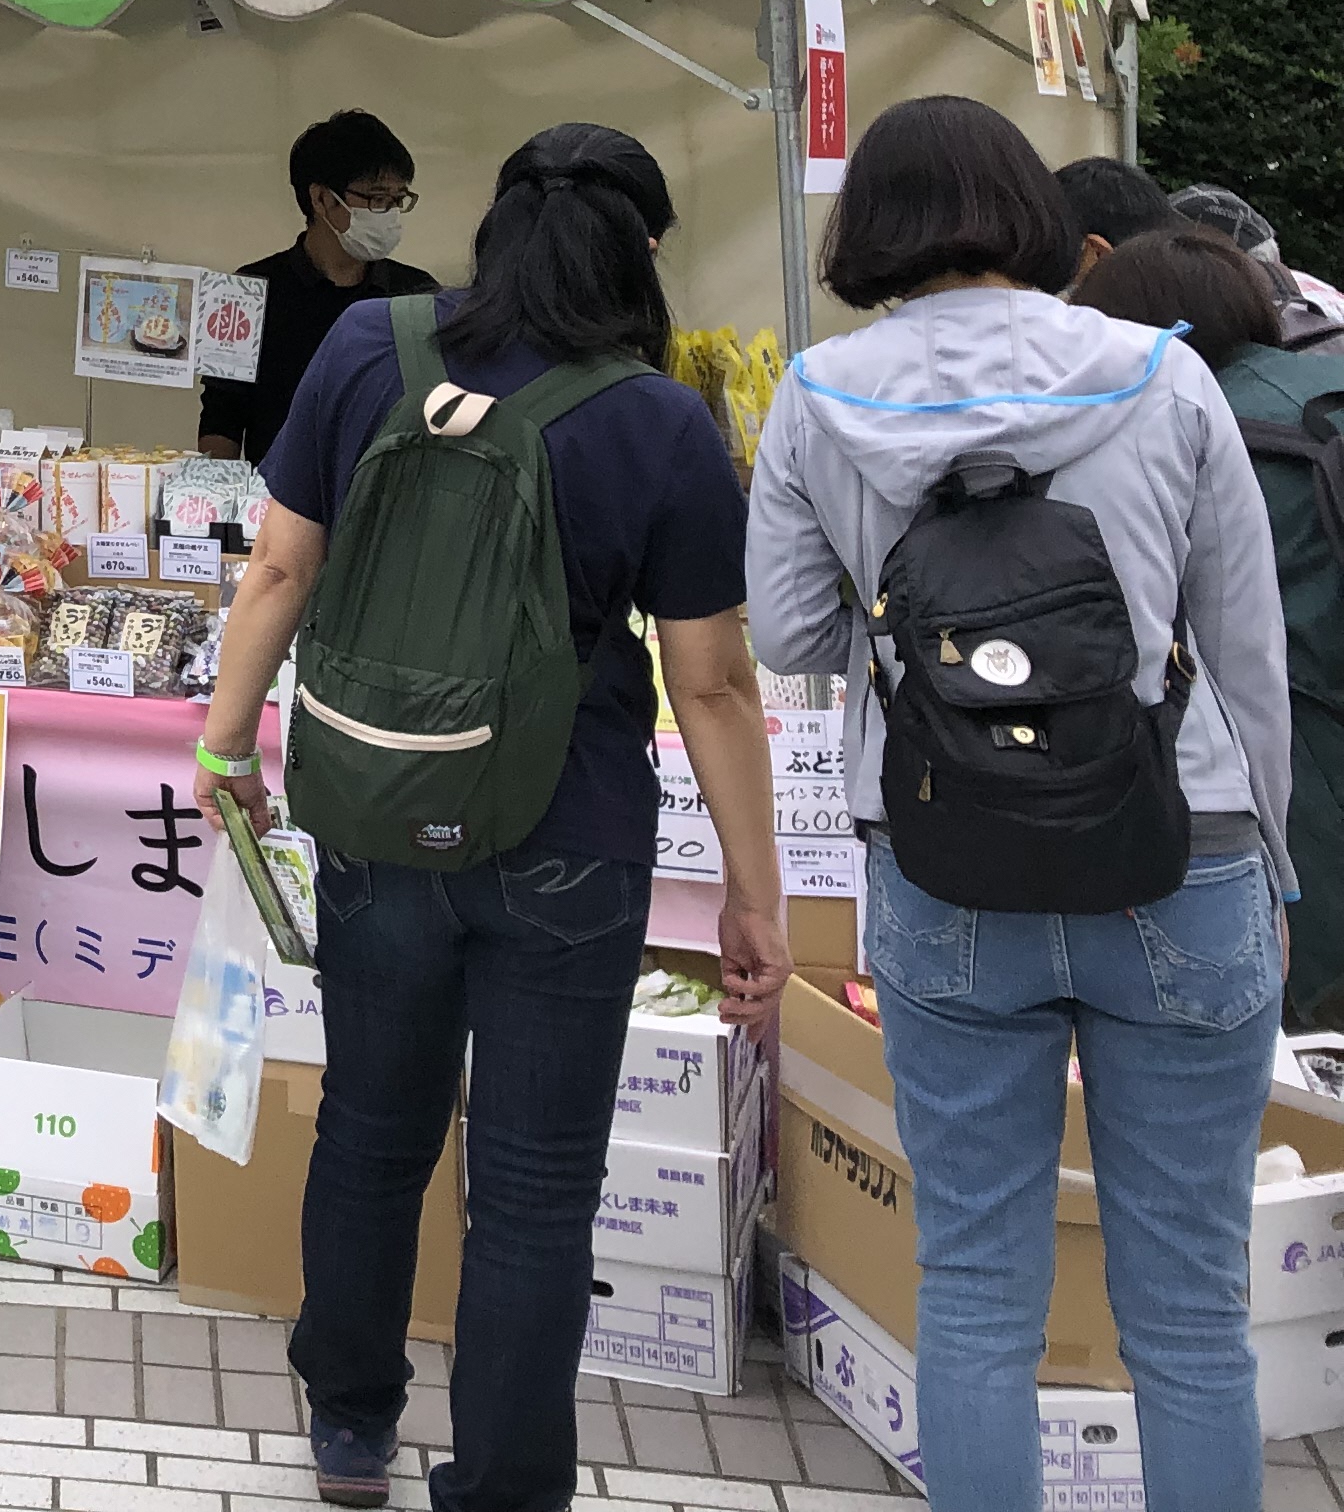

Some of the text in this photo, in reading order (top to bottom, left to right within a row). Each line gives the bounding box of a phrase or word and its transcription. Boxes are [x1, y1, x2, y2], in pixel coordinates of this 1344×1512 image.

[207, 300, 252, 343] 桃
[86, 676, 112, 688] ¥540
[776, 809, 853, 832] 1600
[801, 874, 834, 888] ¥470
[33, 1111, 77, 1139] 110
[593, 1339, 605, 1353] 11
[612, 1342, 624, 1356] 12
[629, 1345, 641, 1359] 13
[646, 1348, 659, 1362] 14
[1076, 1491, 1089, 1505] 10
[1094, 1491, 1106, 1505] 11
